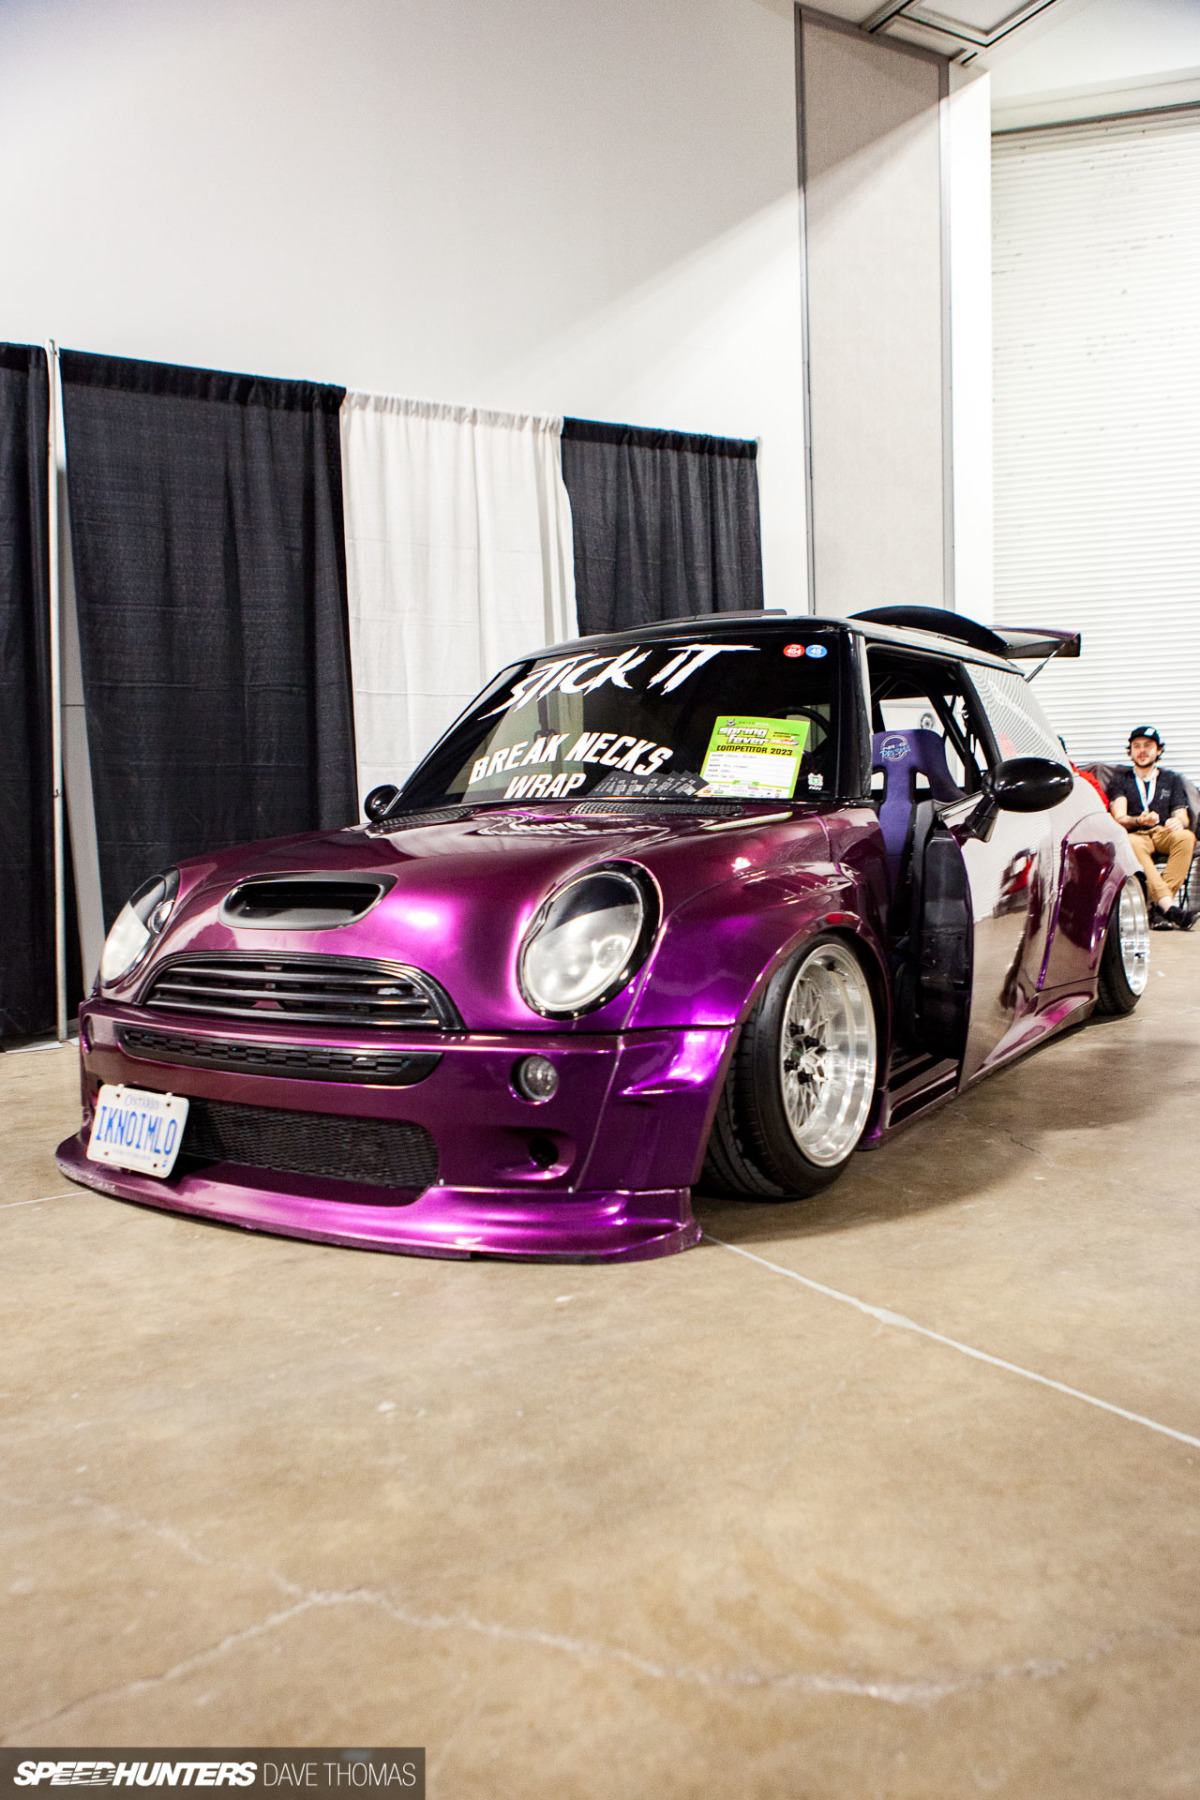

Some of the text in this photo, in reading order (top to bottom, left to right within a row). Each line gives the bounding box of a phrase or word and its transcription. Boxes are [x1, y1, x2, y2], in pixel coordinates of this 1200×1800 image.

[478, 644, 761, 720] STICK IT
[717, 727, 769, 738] spring
[727, 735, 769, 746] fever
[468, 731, 674, 785] BREAK NECKS
[716, 744, 793, 756] COMPETITOR 2023
[503, 773, 587, 799] WRAP
